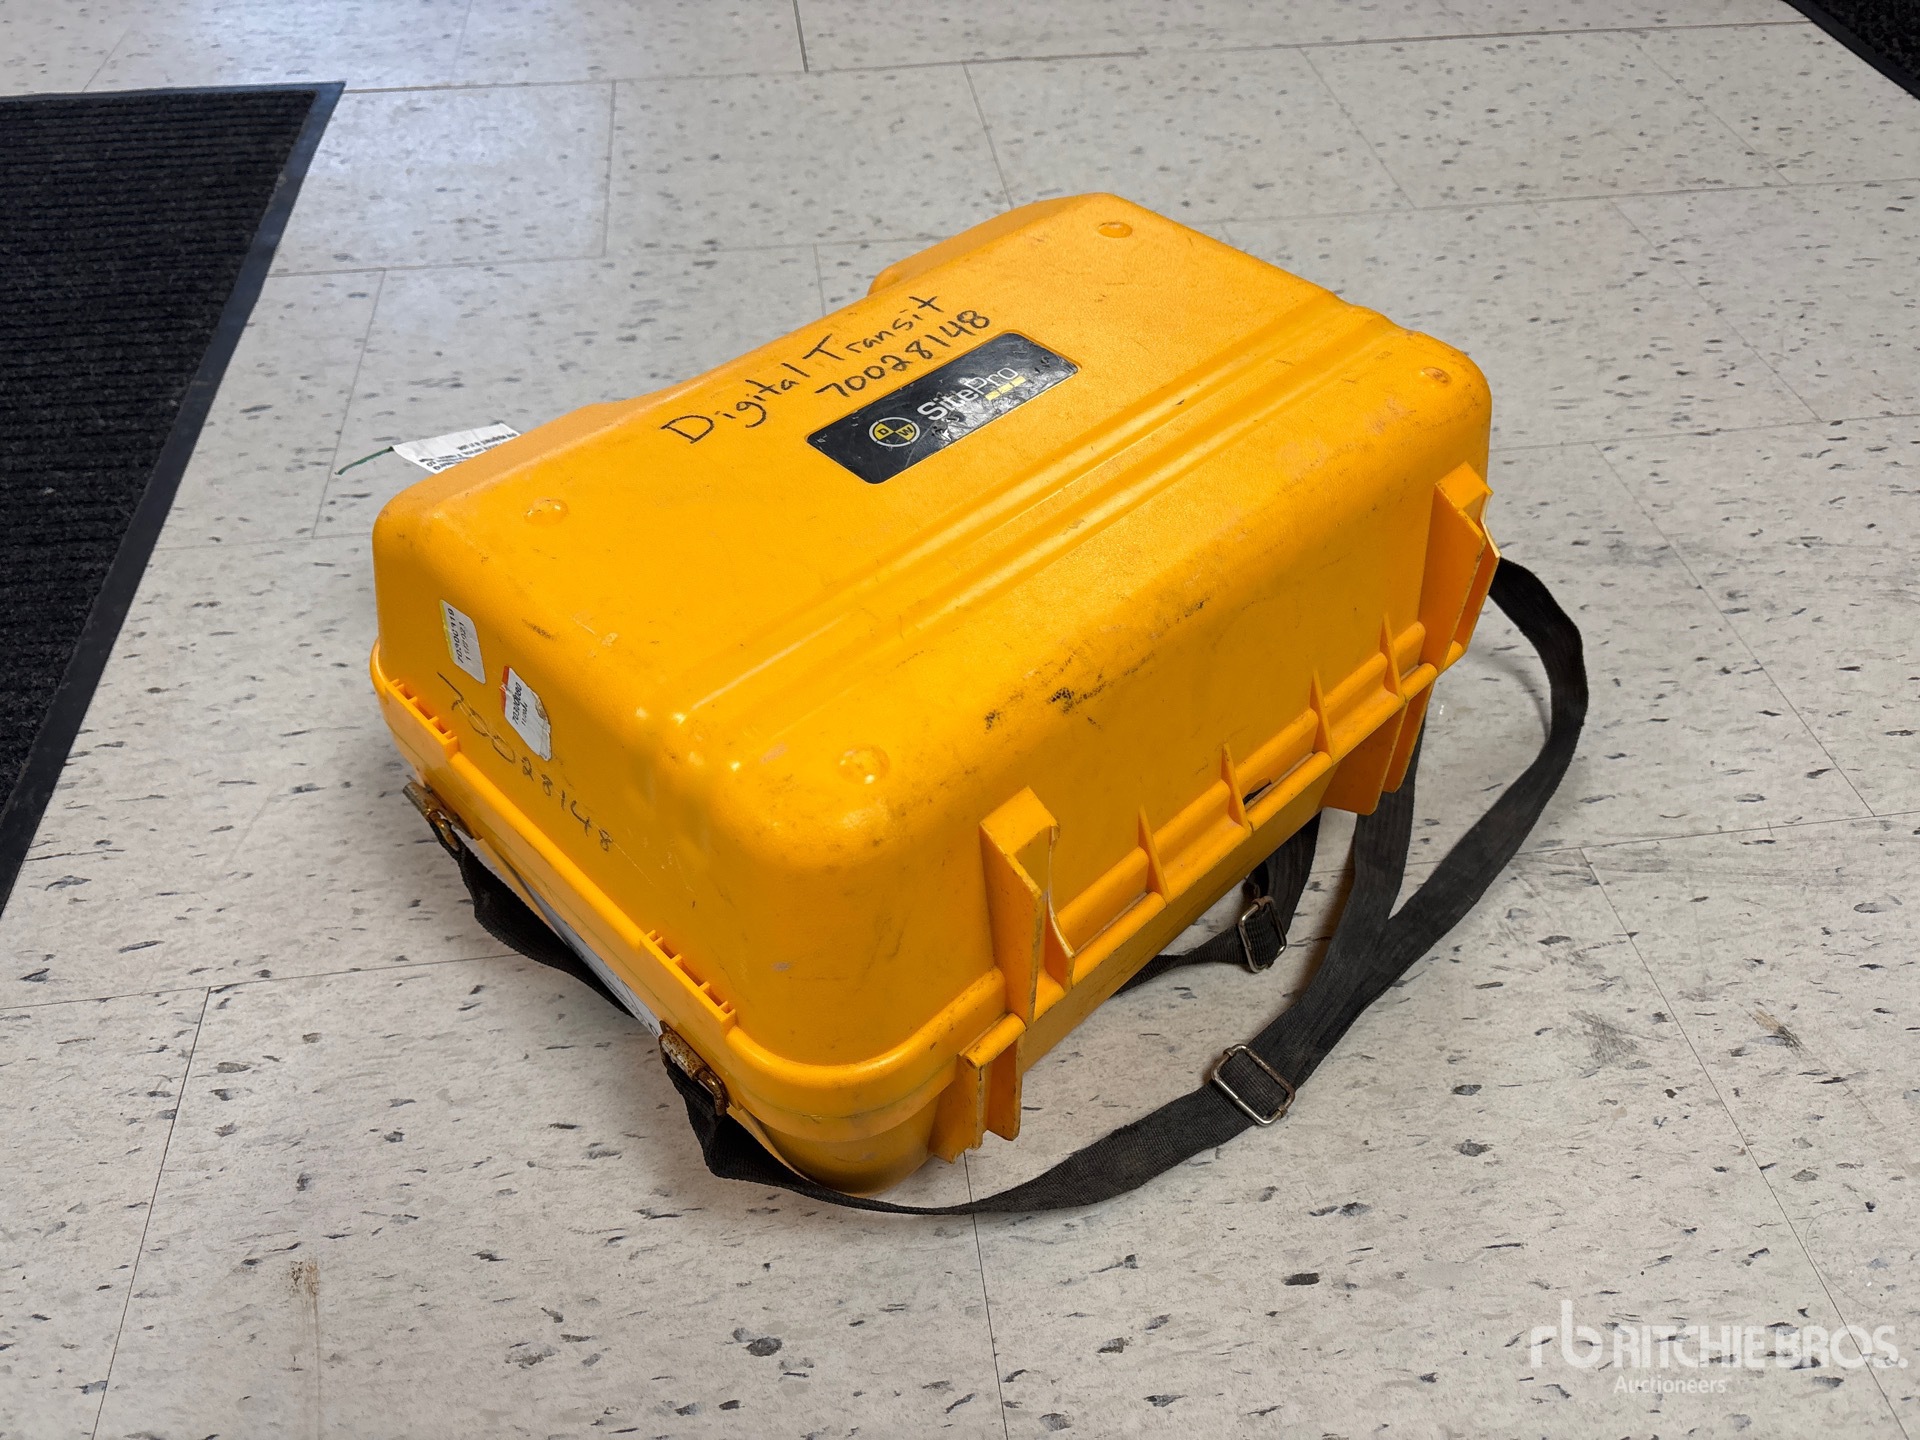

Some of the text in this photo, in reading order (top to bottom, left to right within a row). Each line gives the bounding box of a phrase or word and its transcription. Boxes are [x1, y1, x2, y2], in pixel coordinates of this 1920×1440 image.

[660, 295, 945, 444] Digital Transit
[814, 309, 991, 399] 70028148
[916, 367, 1019, 421] SitePro
[437, 671, 614, 852] 70028148
